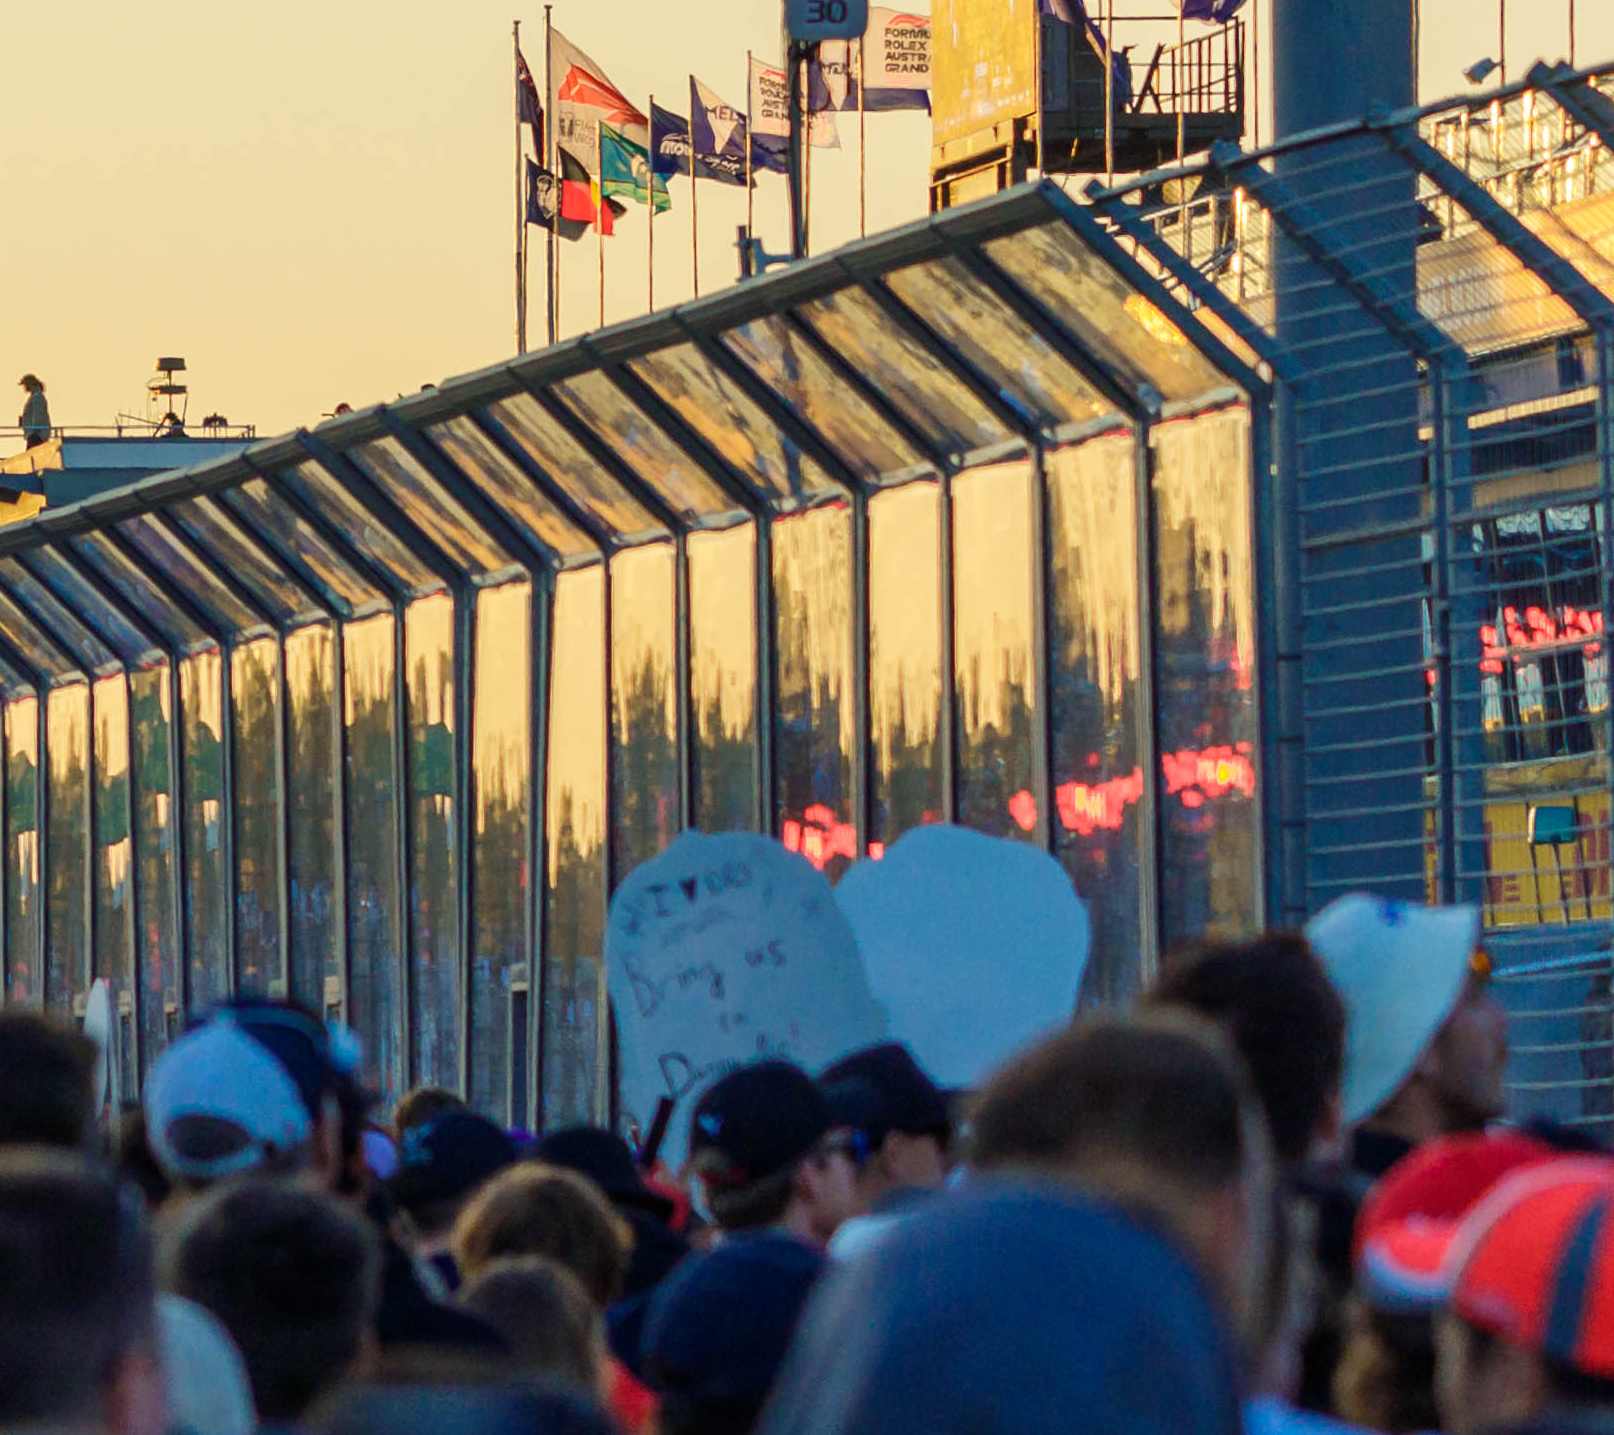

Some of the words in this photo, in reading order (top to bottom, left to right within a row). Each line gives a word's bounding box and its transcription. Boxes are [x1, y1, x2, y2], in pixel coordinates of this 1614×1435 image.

[884, 39, 927, 52] ROLEX
[884, 51, 931, 63] AUSTR
[884, 64, 929, 74] GRAND
